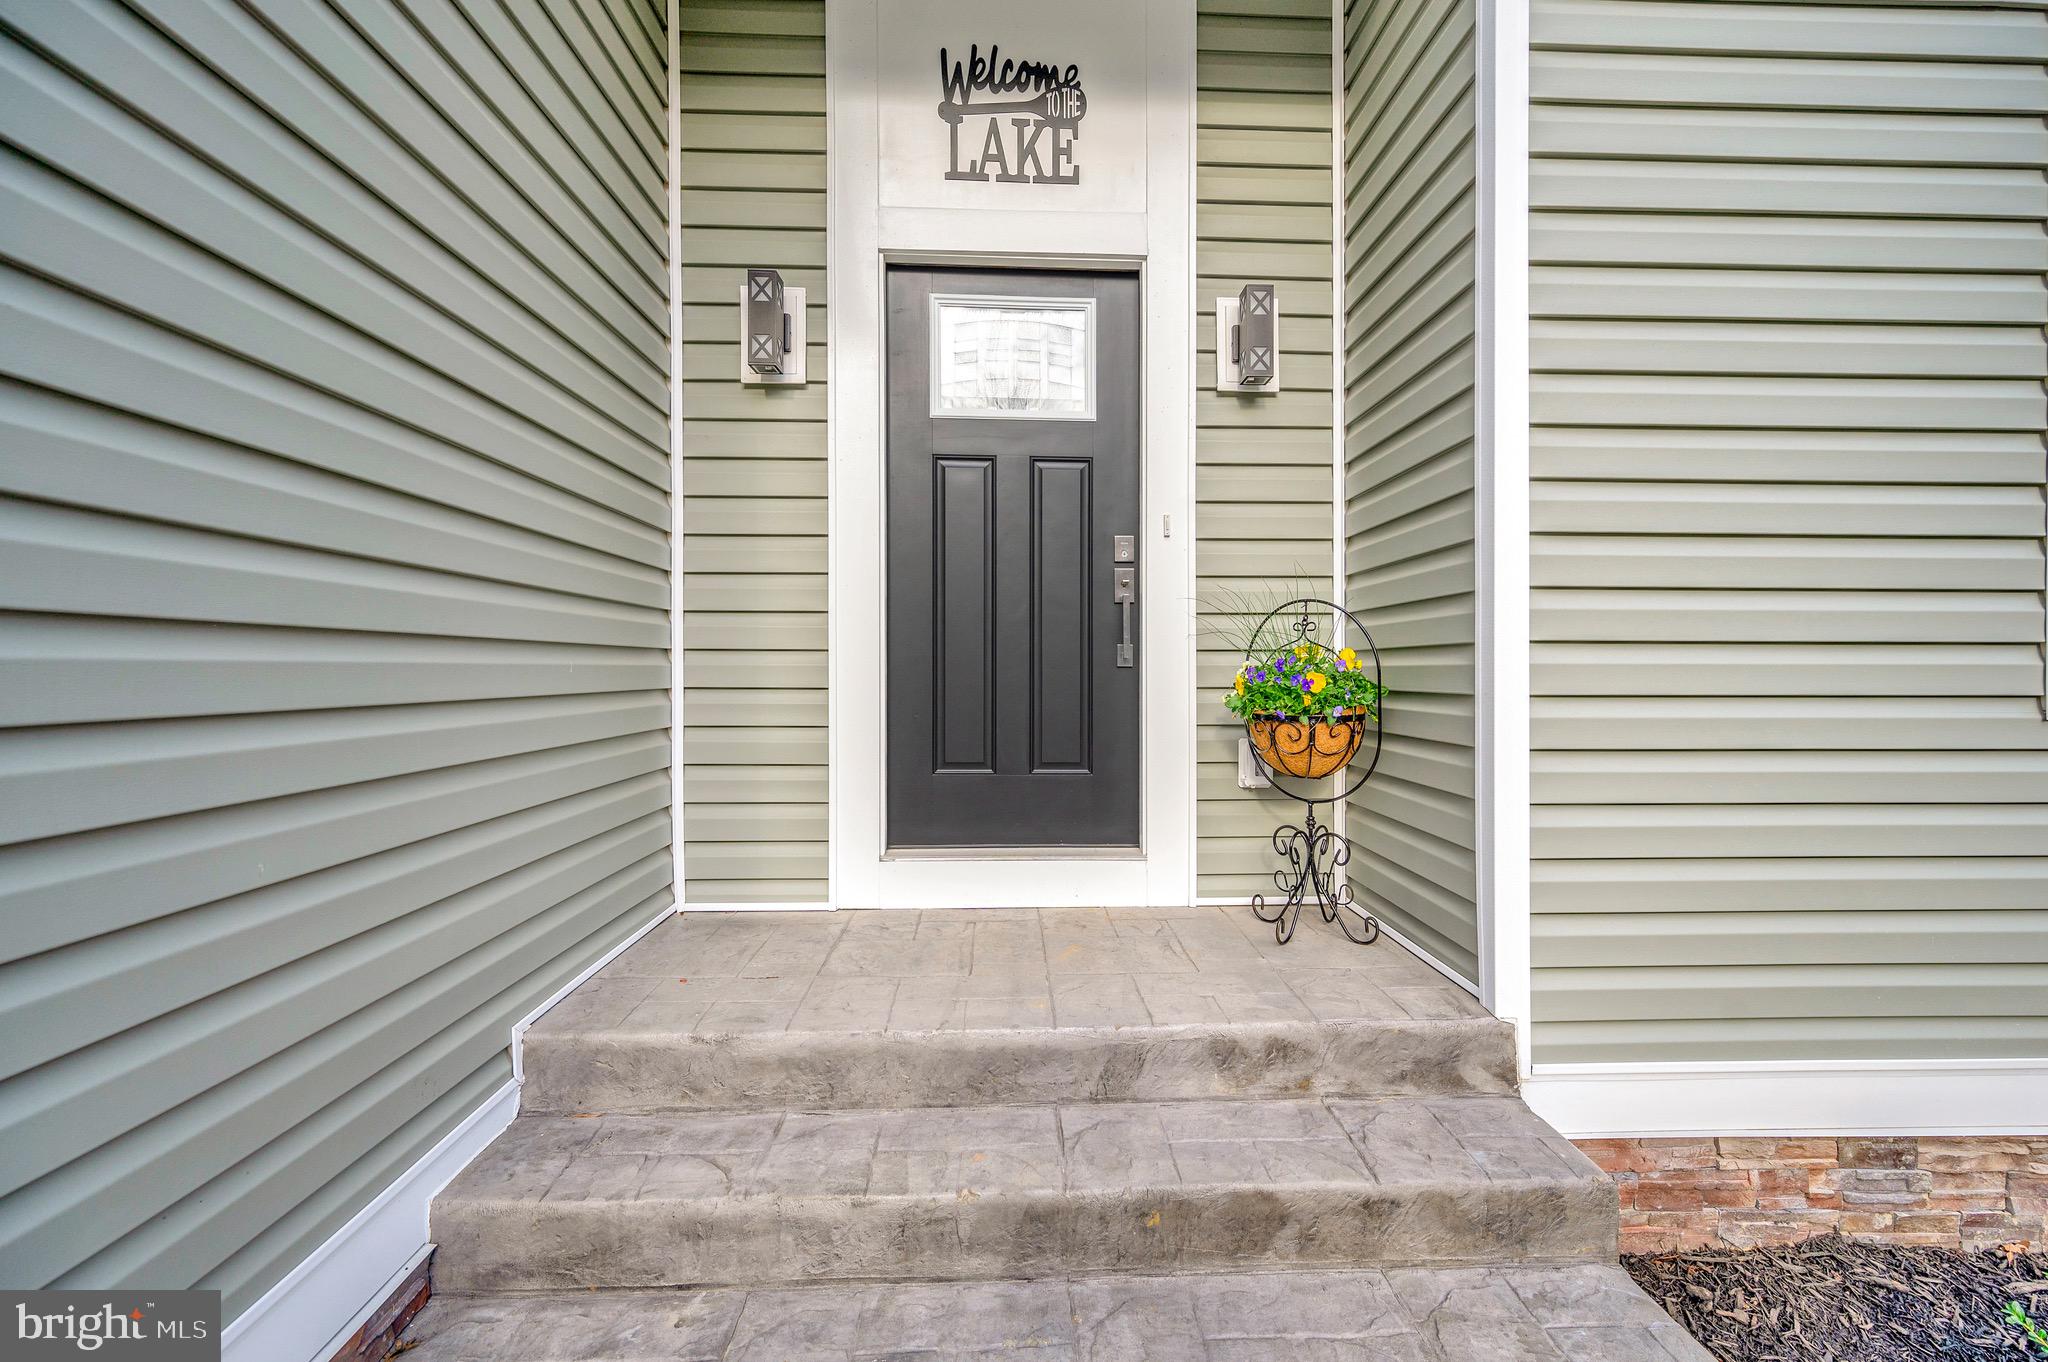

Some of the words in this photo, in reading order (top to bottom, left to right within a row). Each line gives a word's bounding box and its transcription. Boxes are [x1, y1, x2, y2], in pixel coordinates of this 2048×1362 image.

[940, 43, 1081, 104] Welcome
[1046, 91, 1060, 118] TO
[1062, 87, 1081, 119] THE
[945, 115, 1080, 185] LAKE
